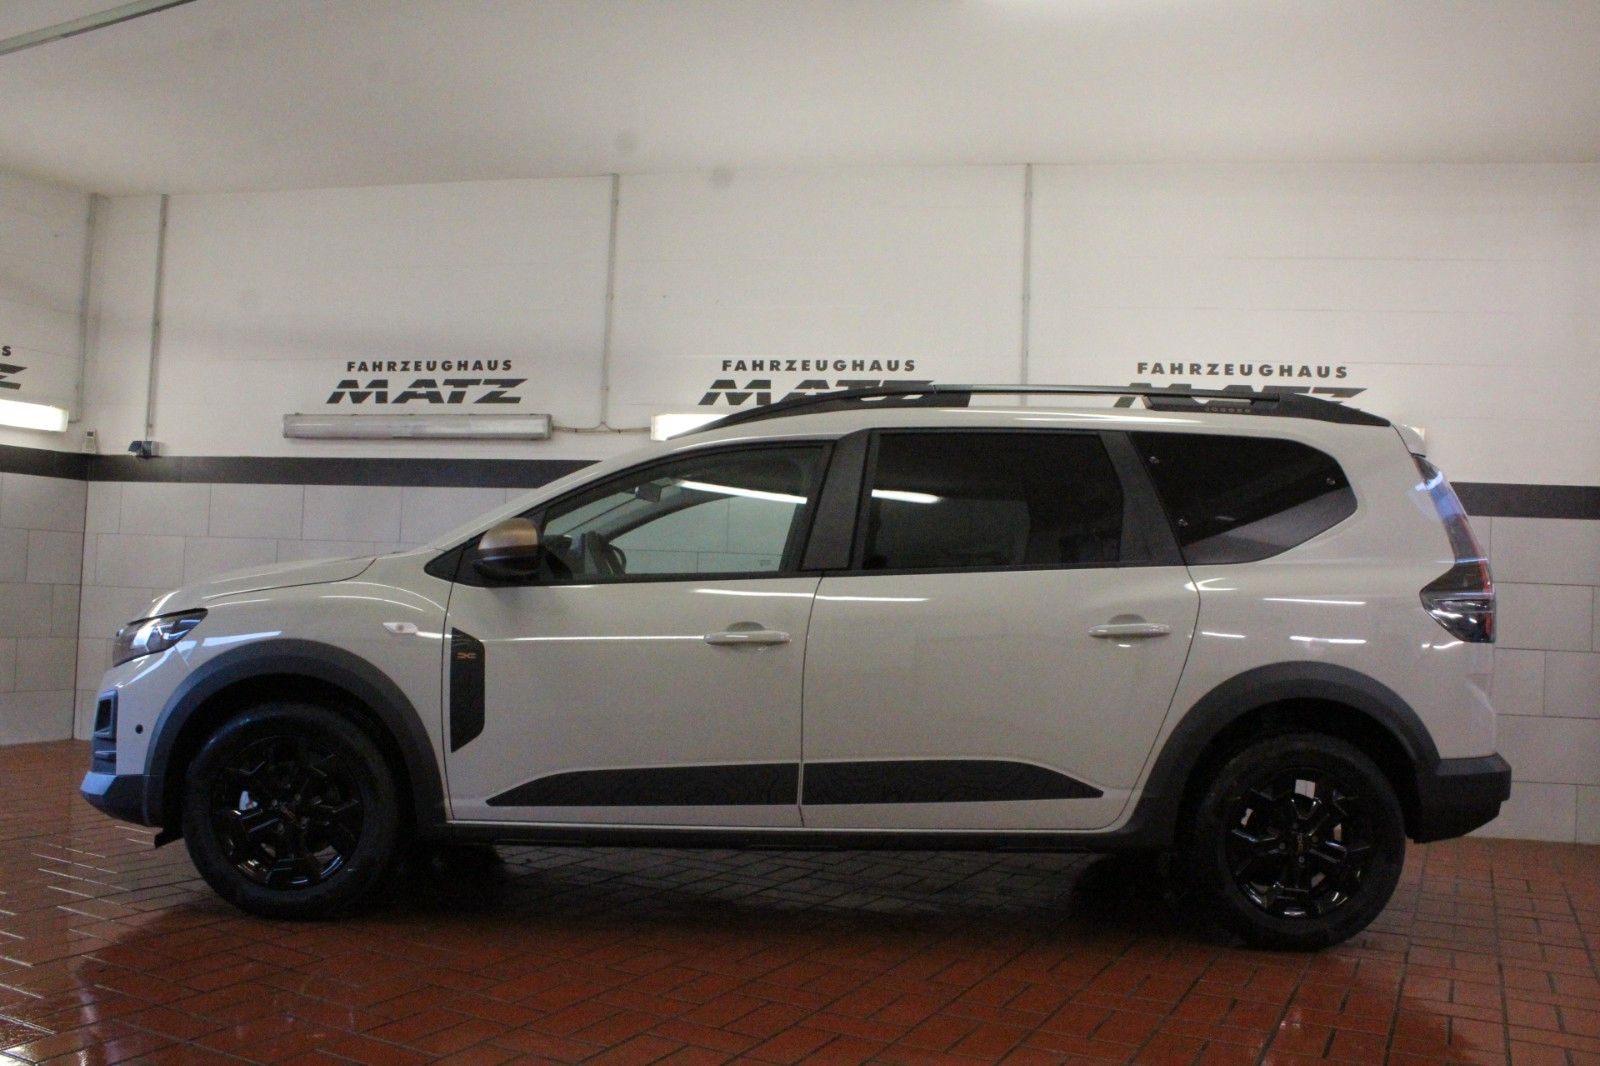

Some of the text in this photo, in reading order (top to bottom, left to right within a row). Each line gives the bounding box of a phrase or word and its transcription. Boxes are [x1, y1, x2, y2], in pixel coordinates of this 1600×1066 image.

[347, 360, 512, 372] FAHRZEUGHAUS
[722, 360, 916, 372] FAHRZEUGHAUS
[1137, 362, 1348, 379] FAHRZEUGHAUS
[326, 378, 528, 404] MATZ
